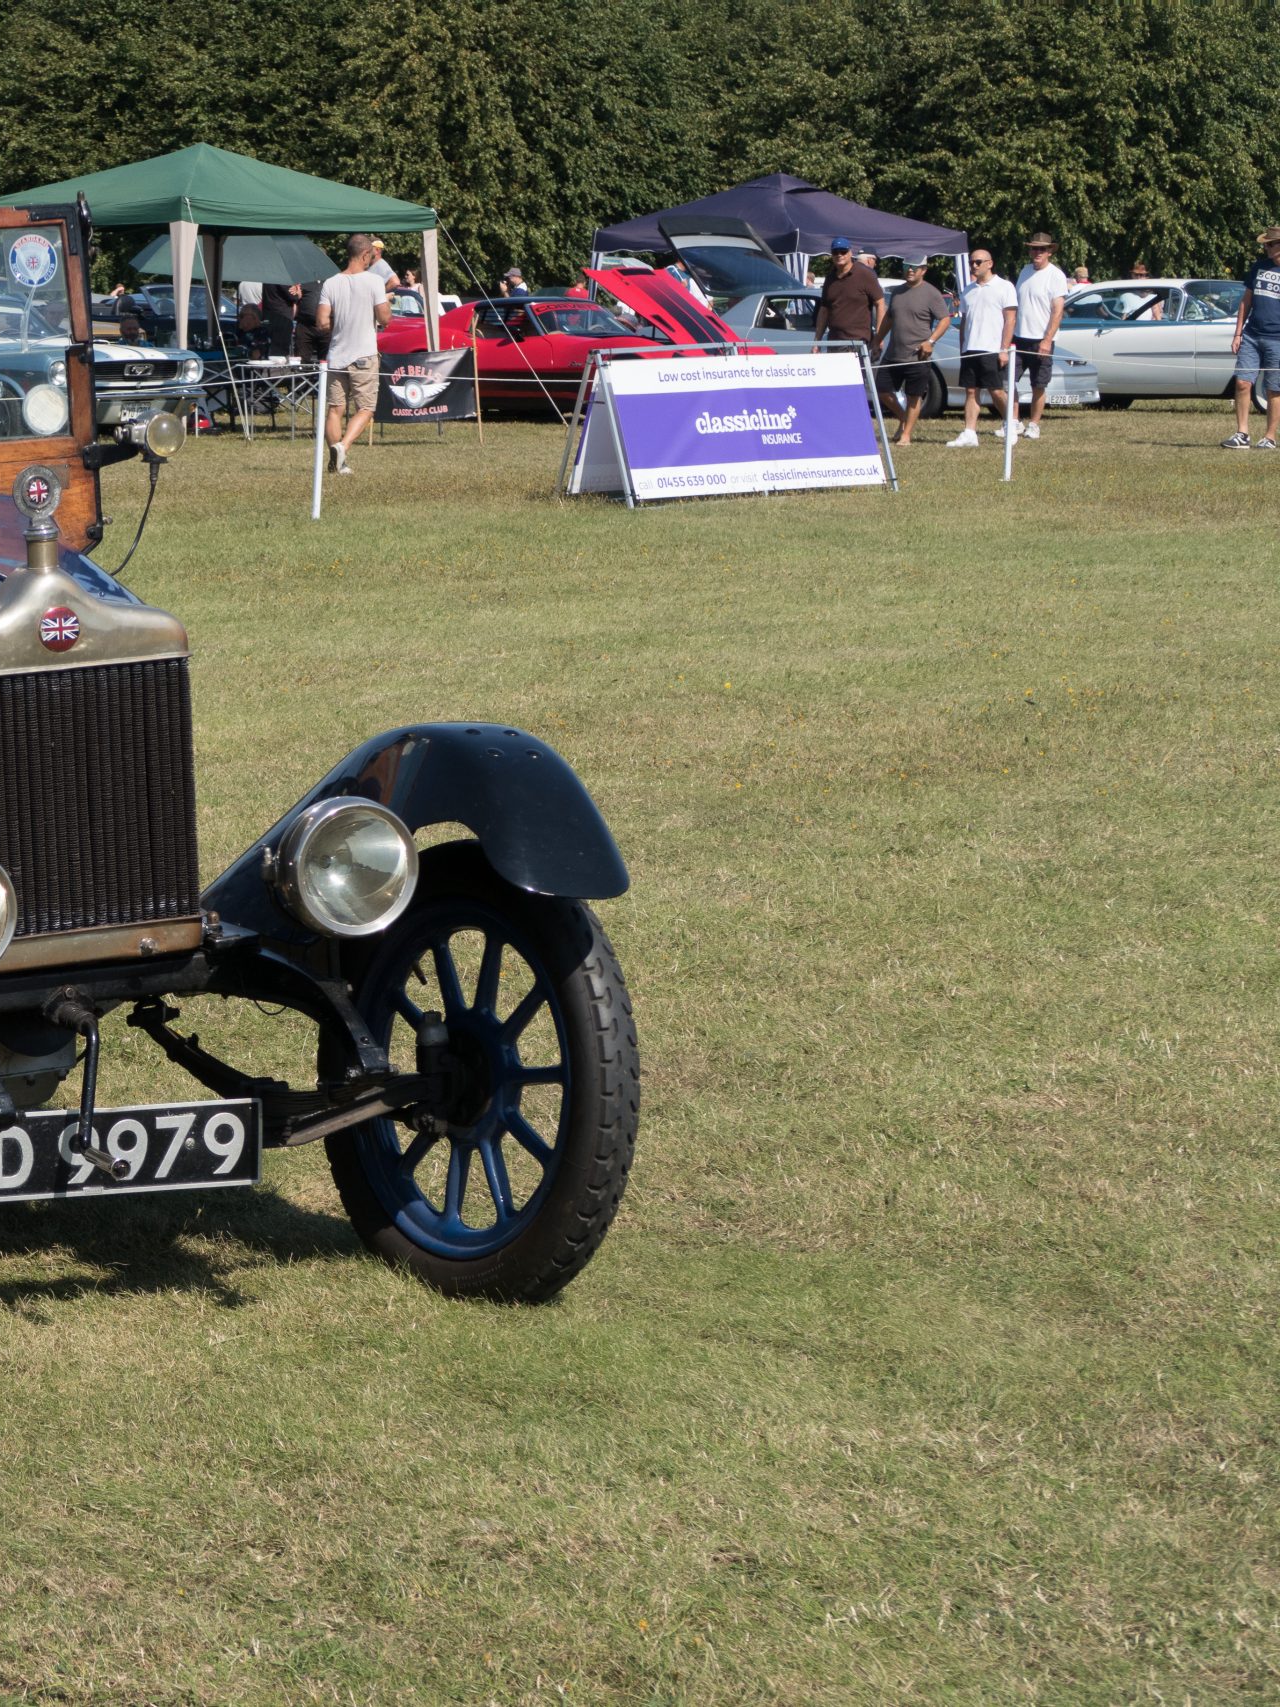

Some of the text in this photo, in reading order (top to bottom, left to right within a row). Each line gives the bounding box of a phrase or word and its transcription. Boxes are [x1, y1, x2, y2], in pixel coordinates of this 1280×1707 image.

[658, 365, 816, 383] Low cost insurance for classic cars
[392, 405, 448, 417] CLASSIC CAR CLUB
[761, 432, 803, 445] INSURANCE
[657, 475, 686, 489] 01455
[687, 474, 706, 488] 639
[707, 473, 727, 486] 000
[762, 464, 880, 482] classiclineinsurance.co.uk
[57, 1111, 246, 1187] 9979
